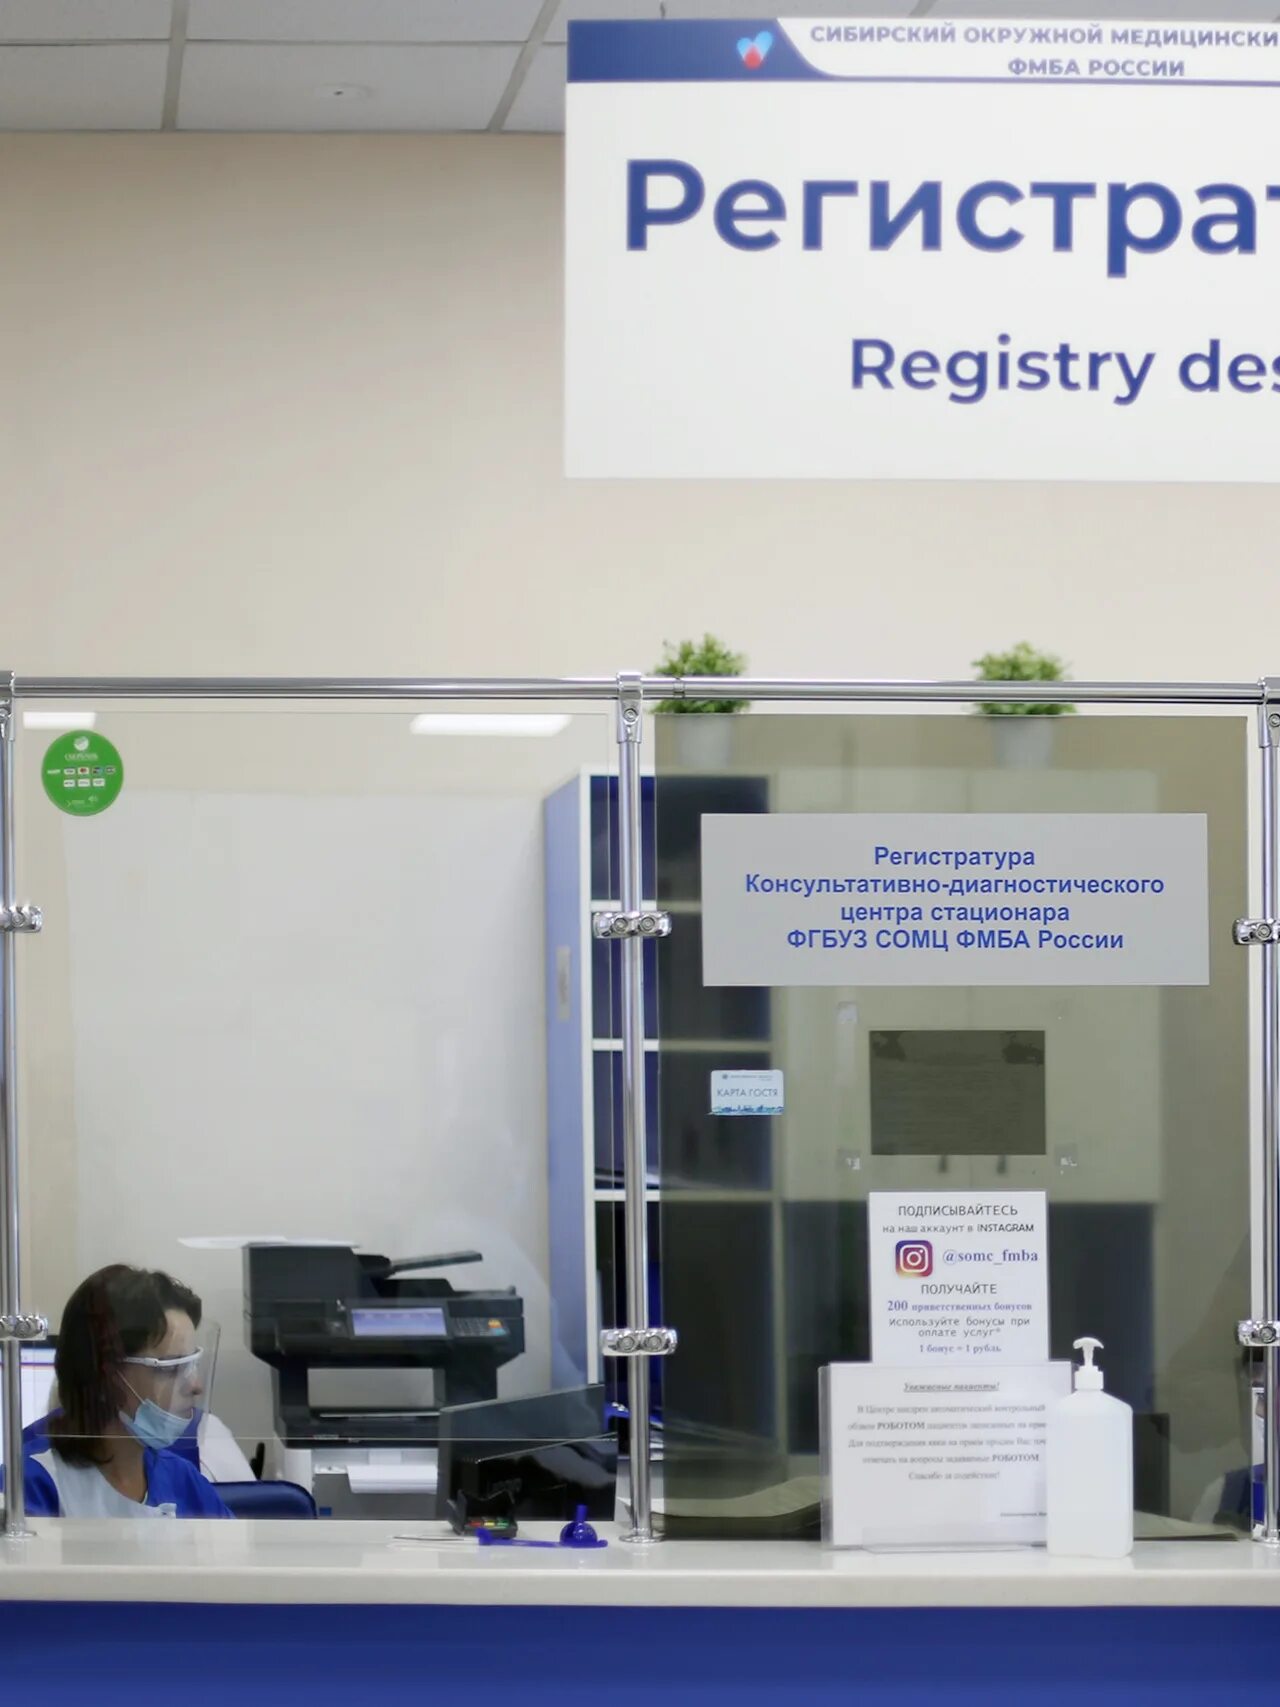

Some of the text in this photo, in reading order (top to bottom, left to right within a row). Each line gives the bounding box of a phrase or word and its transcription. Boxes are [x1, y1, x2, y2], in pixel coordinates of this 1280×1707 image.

[810, 22, 956, 43] СИБИРСКИЙ
[963, 24, 1103, 44] ОКРУЖНОЙ
[1007, 57, 1185, 77] ФМБА РОССИИ
[850, 333, 1156, 406] Registry
[874, 846, 1035, 871] Регистратура
[745, 873, 1165, 898] Консультативно-диагностического
[840, 906, 1070, 926] центра стационара
[787, 929, 1124, 953] ФГБУЗ СОМЦ ФМБА России
[717, 1088, 778, 1098] КАРТА ГОСТЯ
[898, 1203, 1018, 1218] ПОДПИСЫВАЙТЕСЬ
[882, 1225, 895, 1233] на
[898, 1225, 918, 1233] наш
[920, 1225, 964, 1234] аккаунт
[967, 1225, 973, 1233] в
[942, 1249, 1039, 1266] @somc_fmba
[920, 1281, 997, 1295] ПОЛУЧАЙТЕ
[887, 1300, 1033, 1313] 200 приветственных бонусов
[965, 1316, 1005, 1328] бонусы
[1010, 1318, 1030, 1328] при
[918, 1328, 957, 1338] оплате
[926, 1343, 955, 1355] бонус
